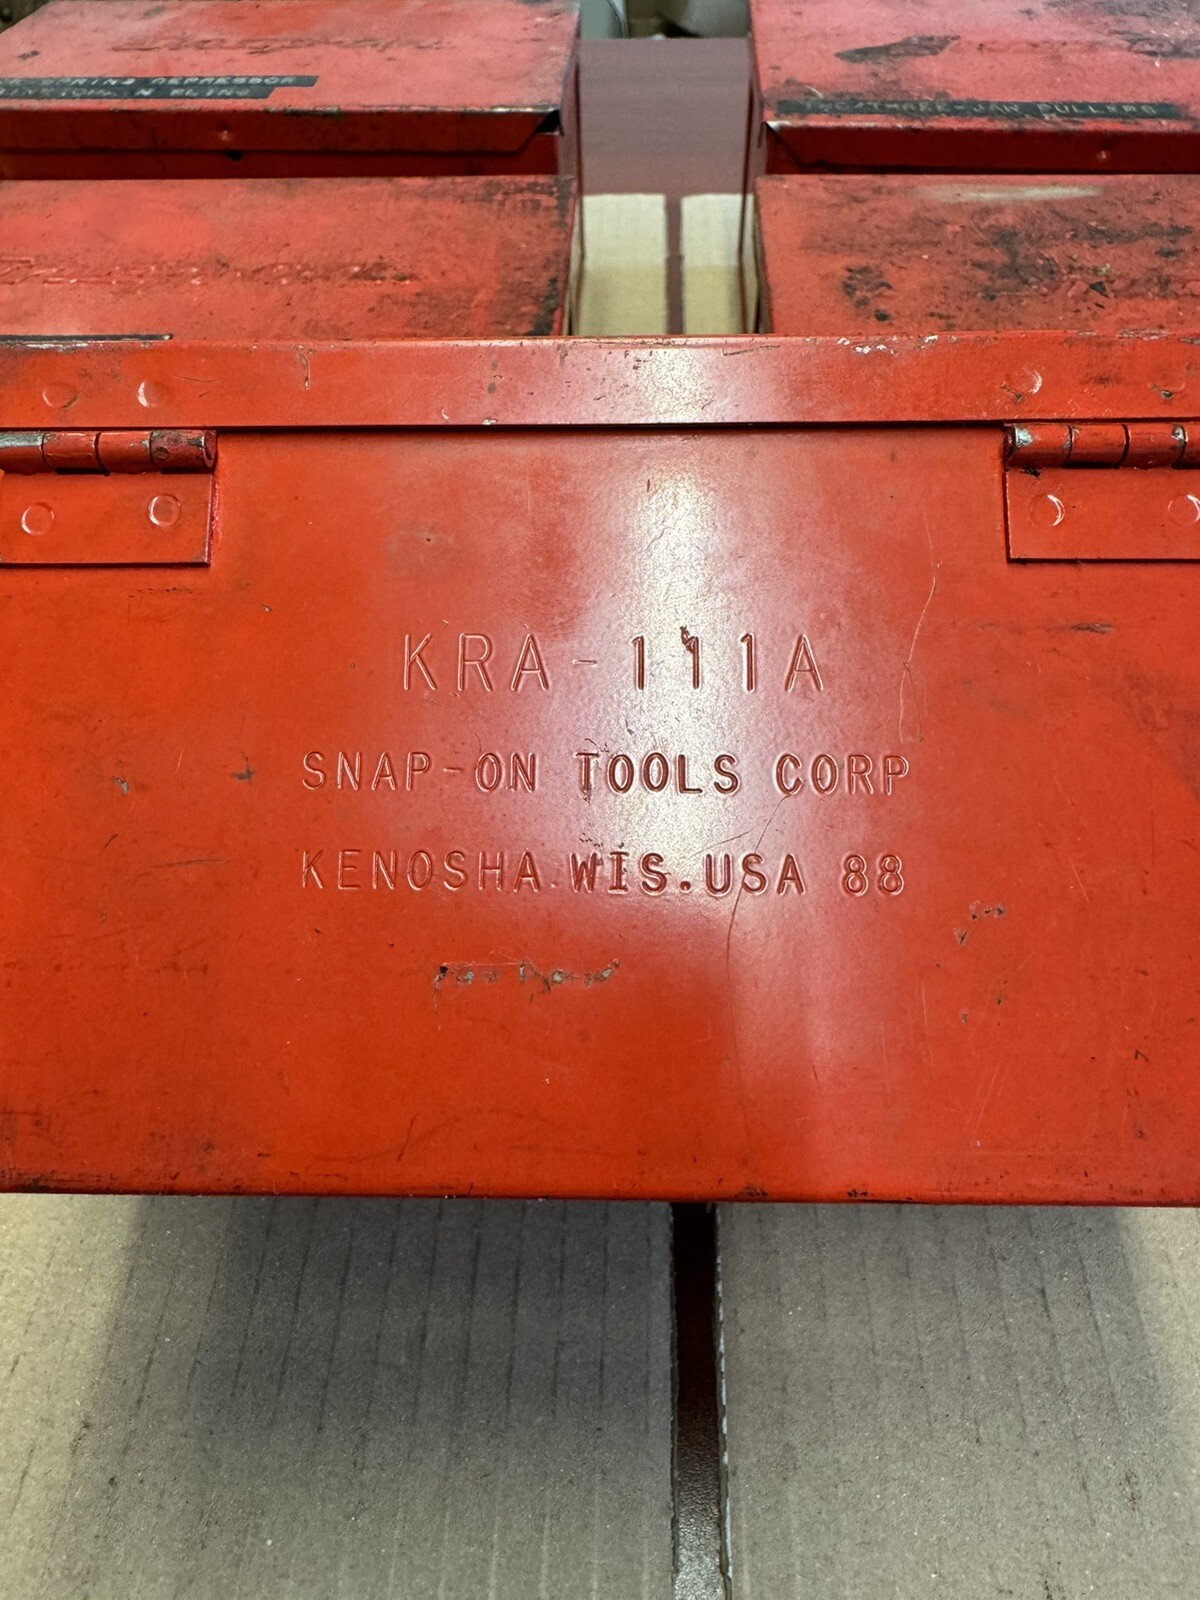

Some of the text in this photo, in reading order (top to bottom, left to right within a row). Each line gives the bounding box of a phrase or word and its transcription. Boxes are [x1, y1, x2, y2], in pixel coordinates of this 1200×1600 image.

[301, 751, 909, 796] SNAP-ON TOOLS CORP
[842, 853, 905, 897] 88
